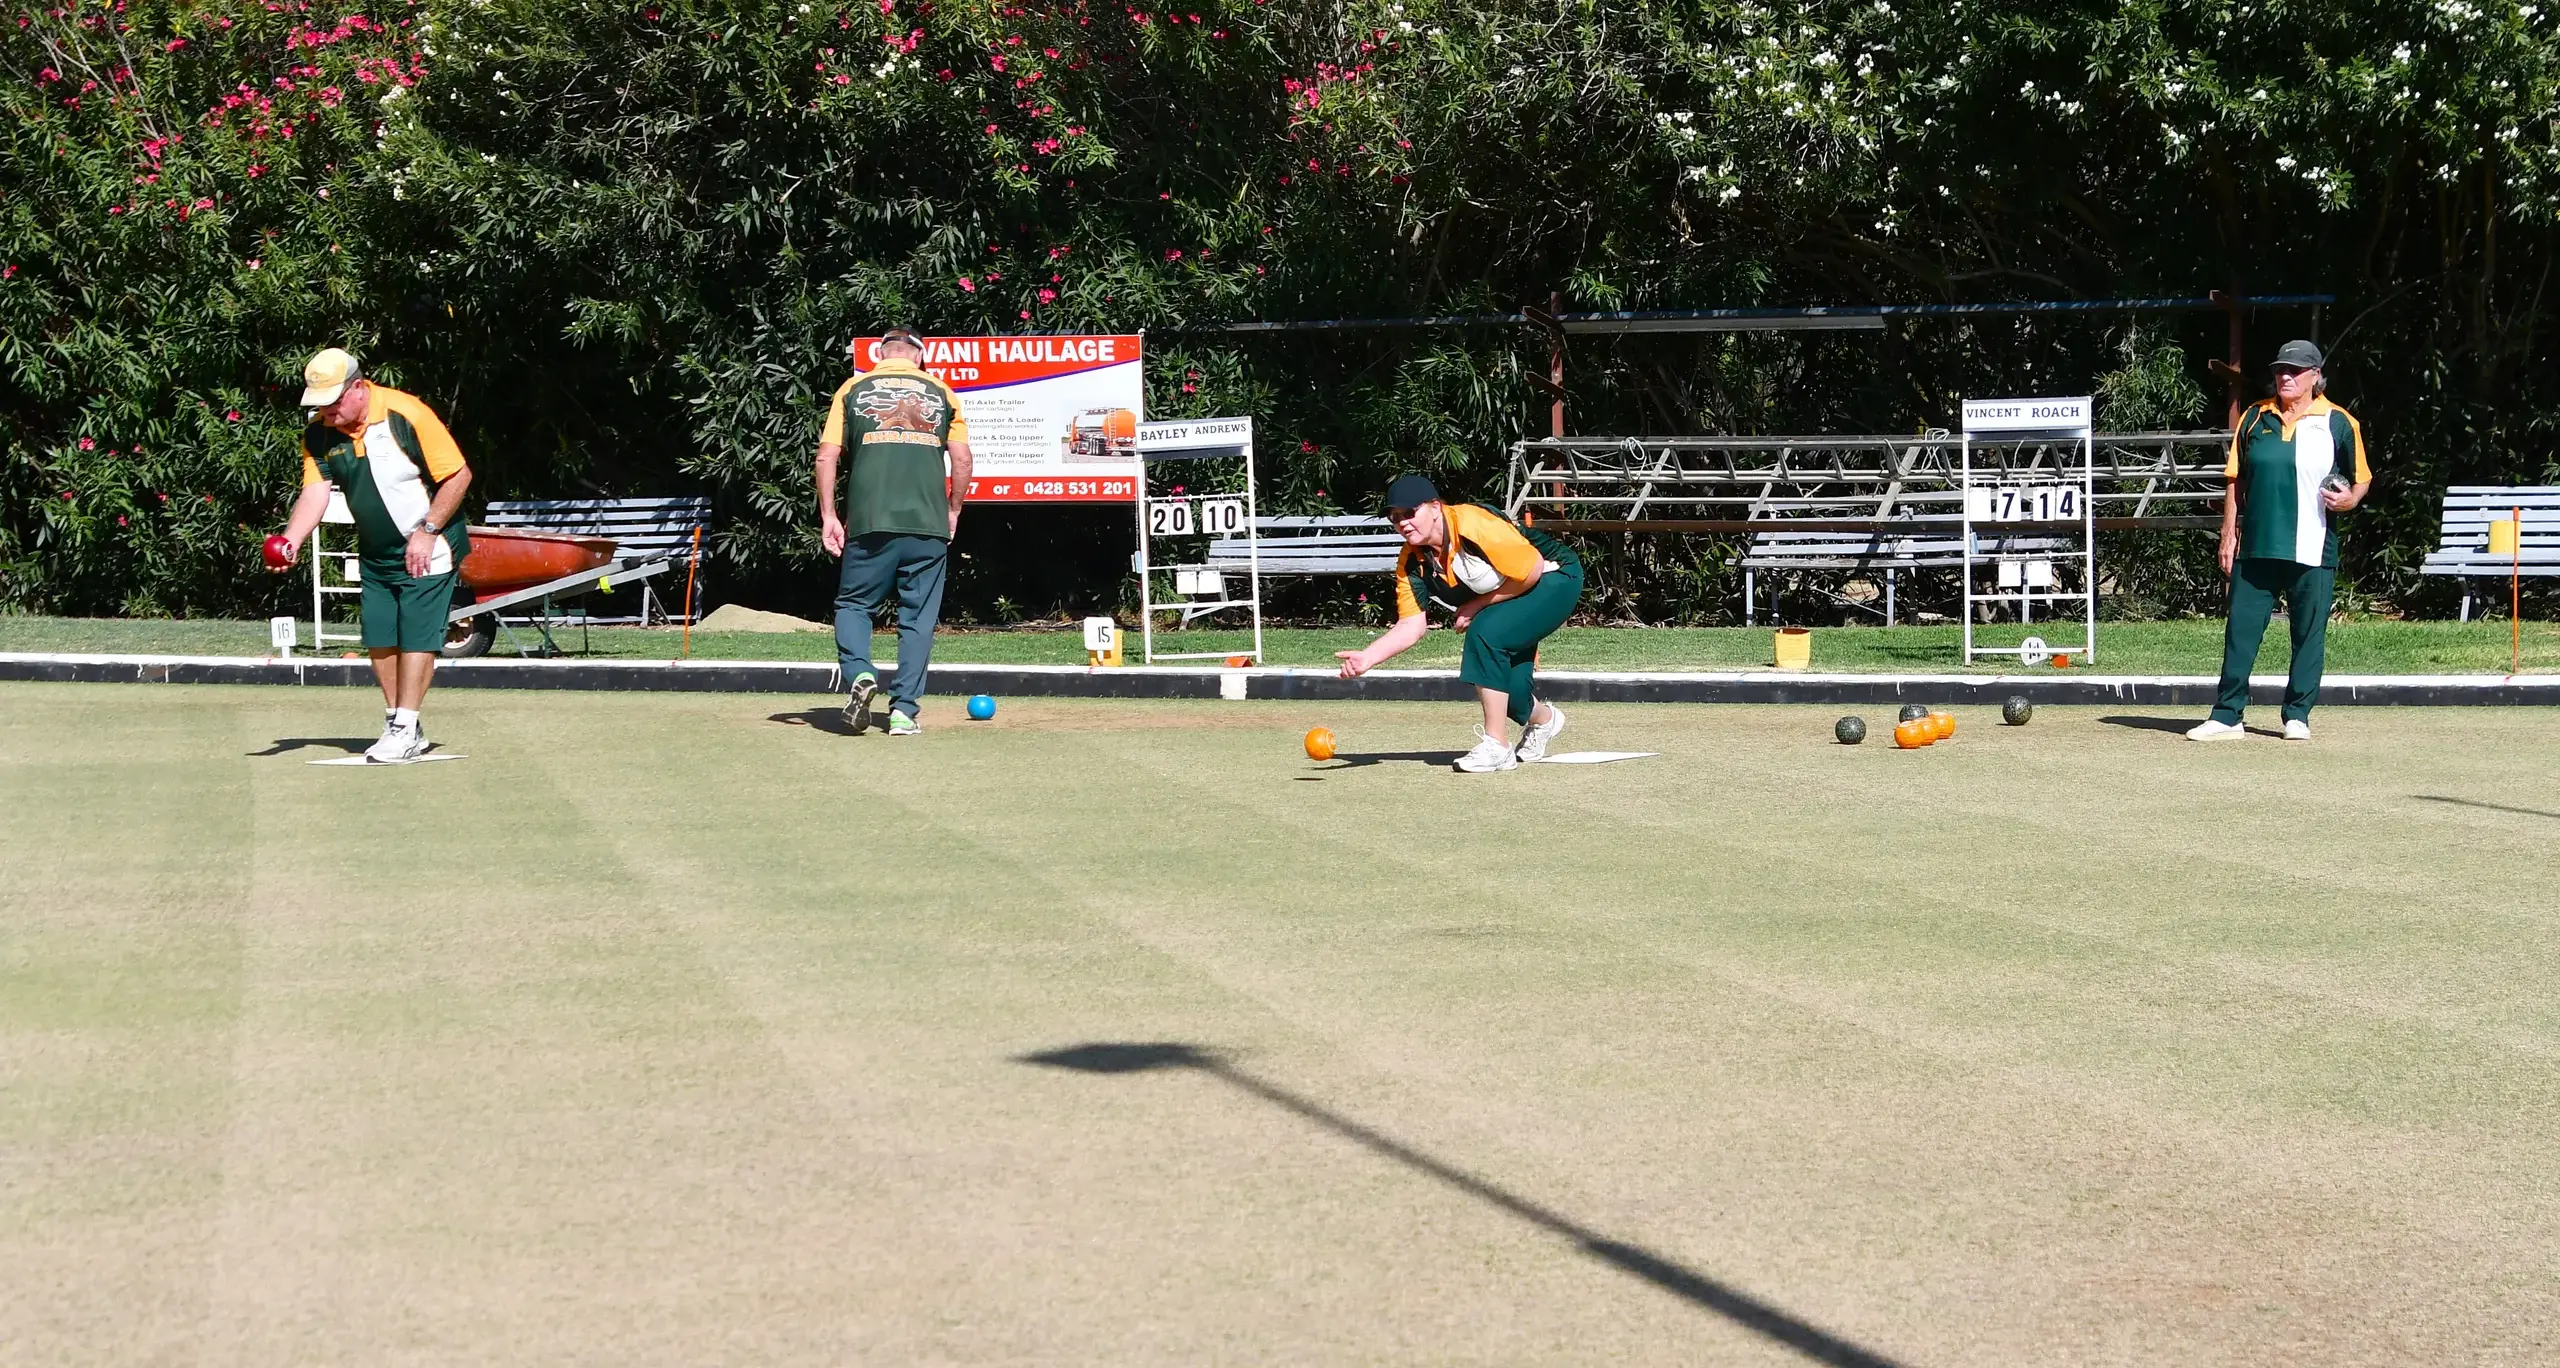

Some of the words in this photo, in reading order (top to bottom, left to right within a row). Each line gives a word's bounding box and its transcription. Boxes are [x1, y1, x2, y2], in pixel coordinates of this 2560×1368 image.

[989, 339, 1115, 363] HAULAGE
[926, 368, 947, 381] TY
[950, 368, 979, 381] LTD
[1966, 407, 2021, 418] VINCENT
[2031, 406, 2080, 418] ROACH
[999, 434, 1017, 442] Dog
[1019, 434, 1044, 442] tipper
[1140, 428, 1188, 441] BAYLEY
[1194, 423, 1247, 435] ANDREWS
[993, 484, 1011, 495] or
[1024, 482, 1064, 495] 0428
[1068, 482, 1097, 495] 531
[1102, 482, 1132, 495] 201
[2002, 493, 2015, 519] 7
[2040, 491, 2074, 520] 14
[1153, 507, 1185, 533] 20
[1208, 505, 1236, 531] 10
[278, 622, 290, 640] 16
[1097, 626, 1111, 643] 15
